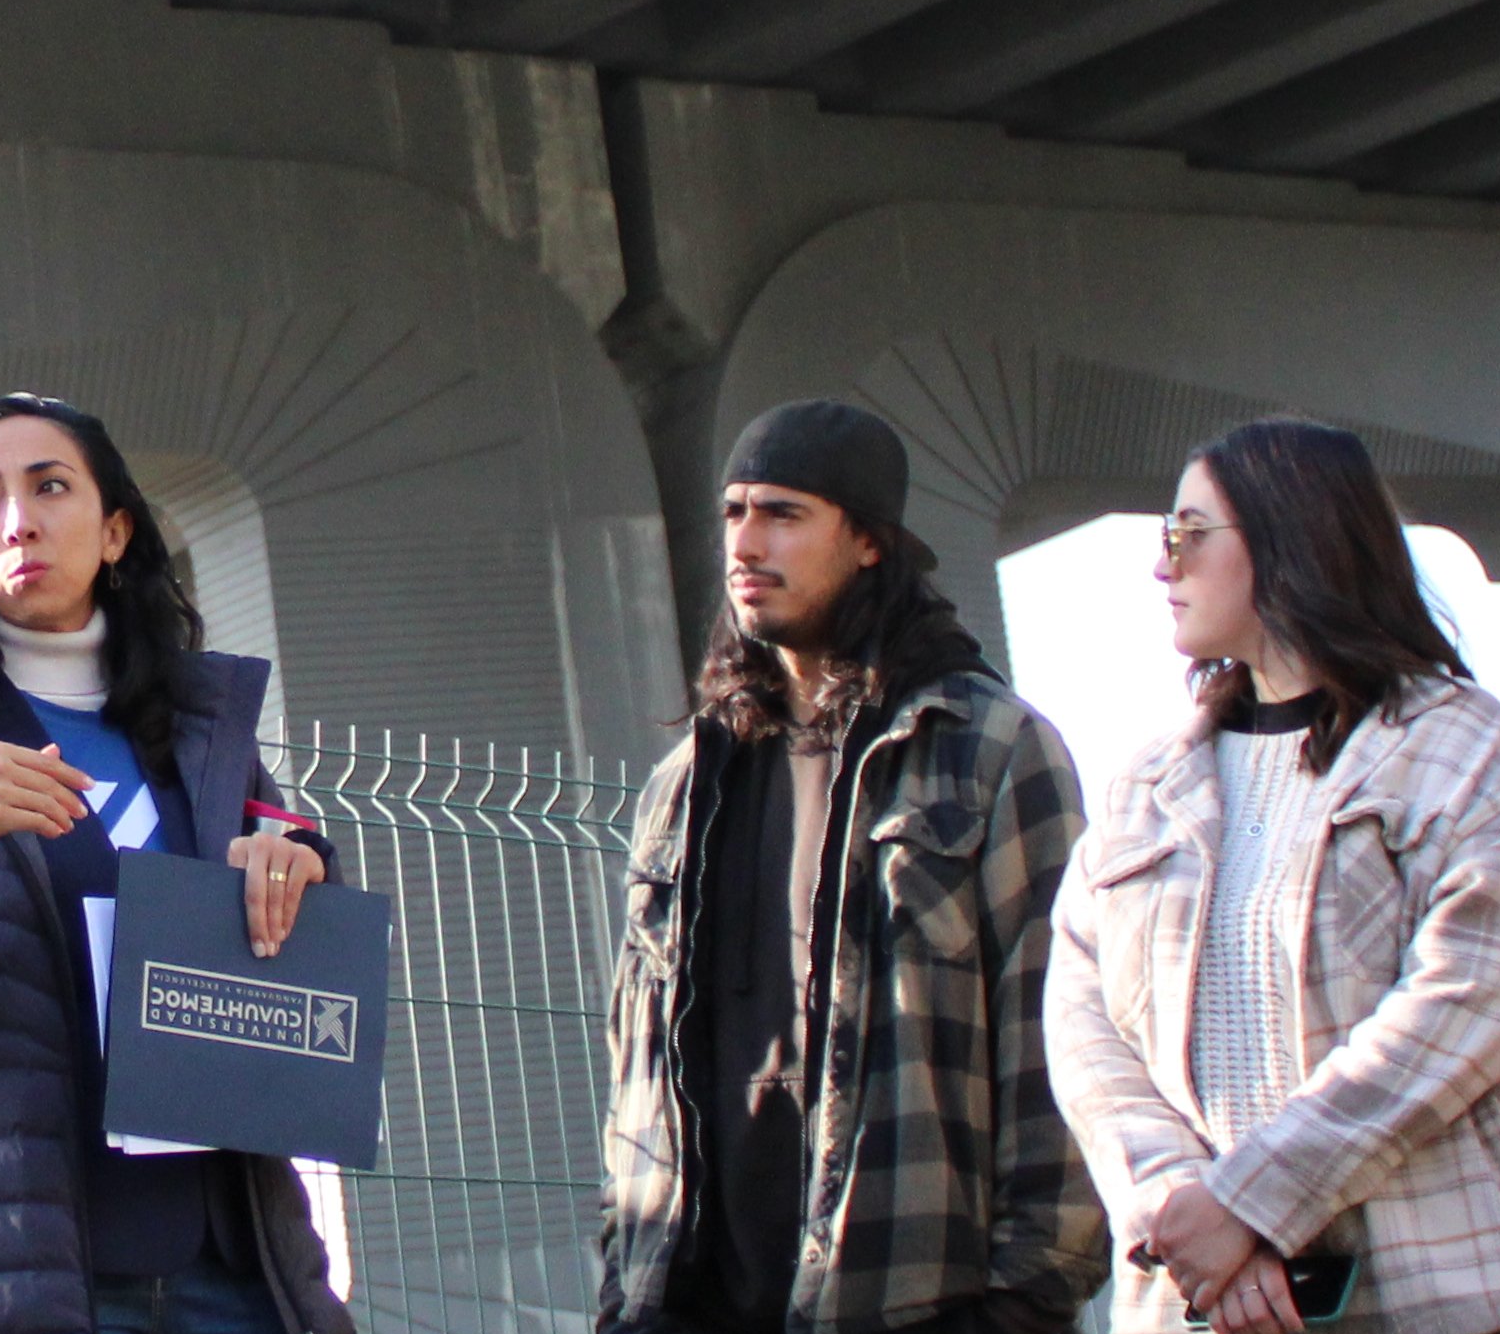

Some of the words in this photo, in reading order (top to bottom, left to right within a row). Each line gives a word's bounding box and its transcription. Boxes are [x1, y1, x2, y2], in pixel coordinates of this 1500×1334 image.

[153, 973, 219, 990] EXCELENCIA
[235, 988, 302, 1004] VANGUARDIA
[151, 1008, 302, 1043] UNIVERSIDAD
